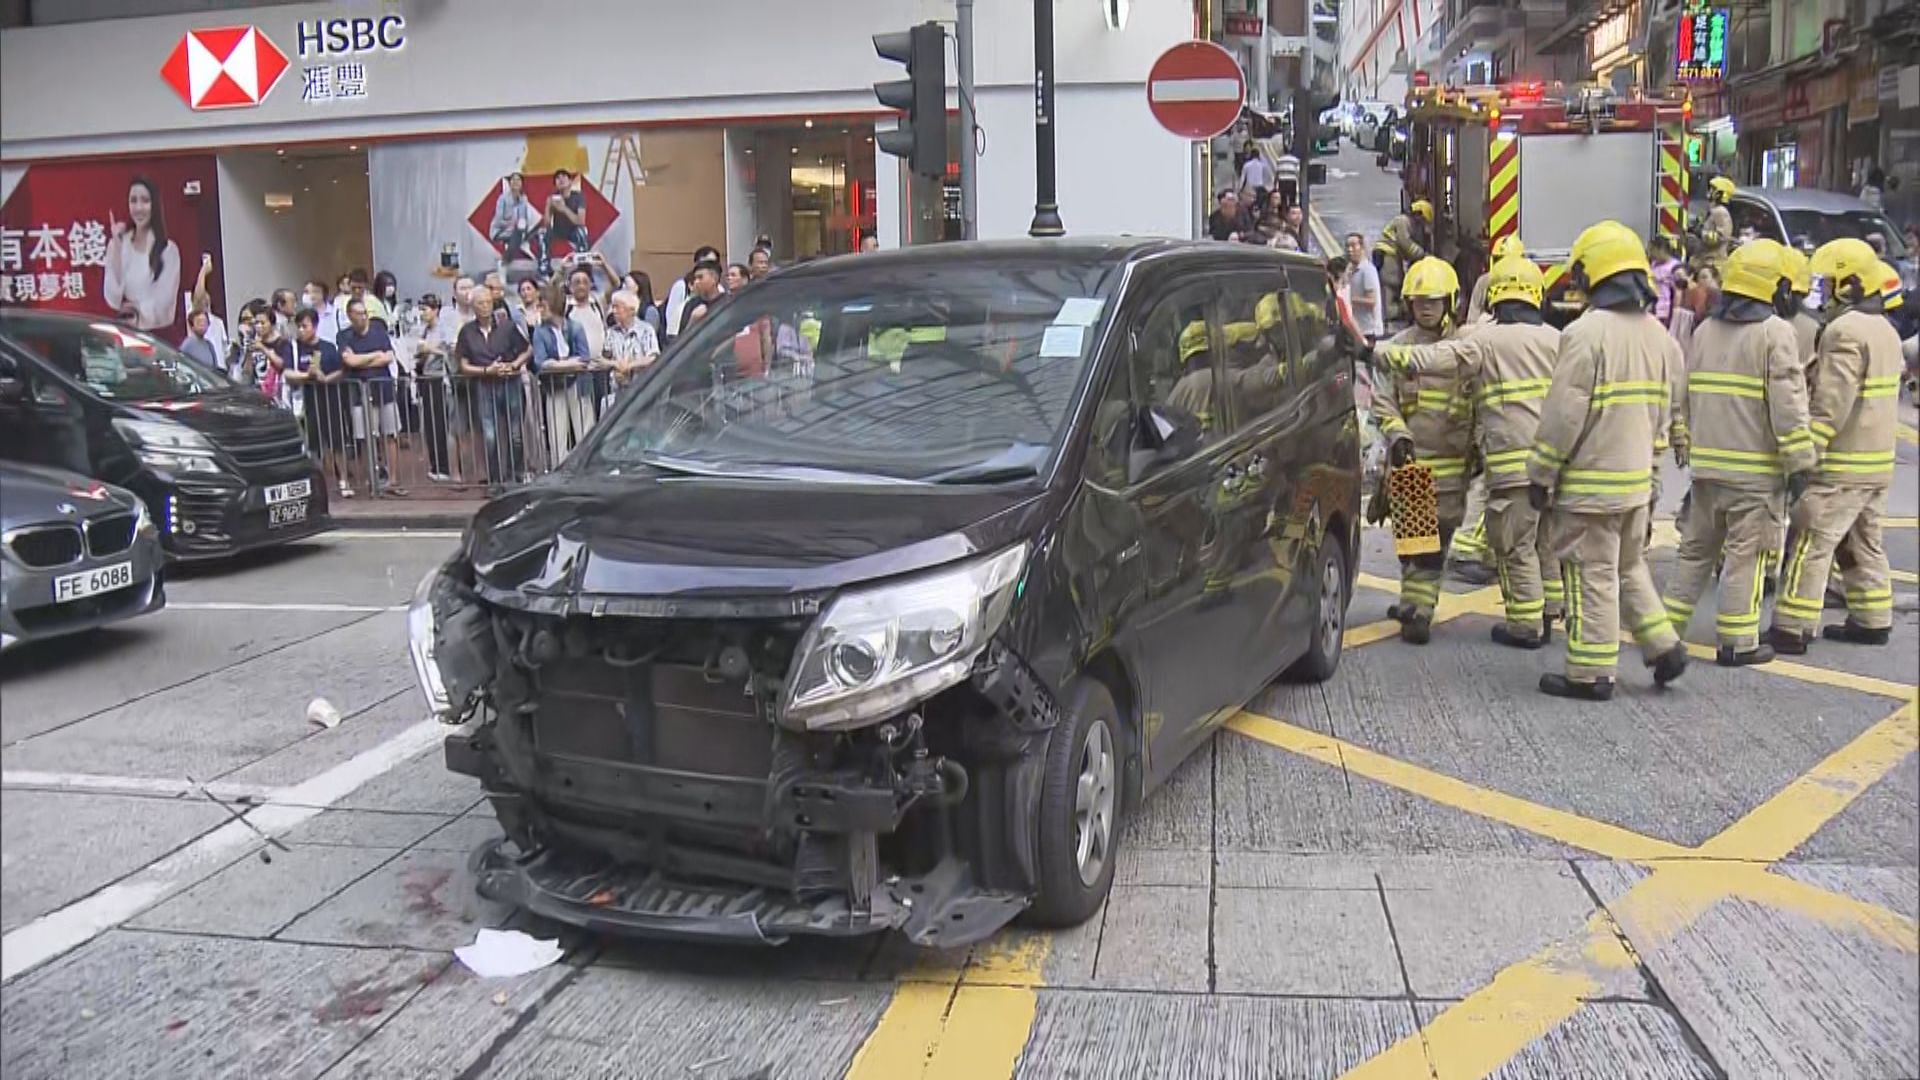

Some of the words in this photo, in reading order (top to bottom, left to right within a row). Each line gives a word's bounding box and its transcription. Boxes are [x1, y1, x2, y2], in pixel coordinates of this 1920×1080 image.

[297, 15, 404, 55] HSBC
[0, 221, 106, 270] 有本錢
[60, 577, 83, 599] FE
[91, 566, 128, 590] 6088
